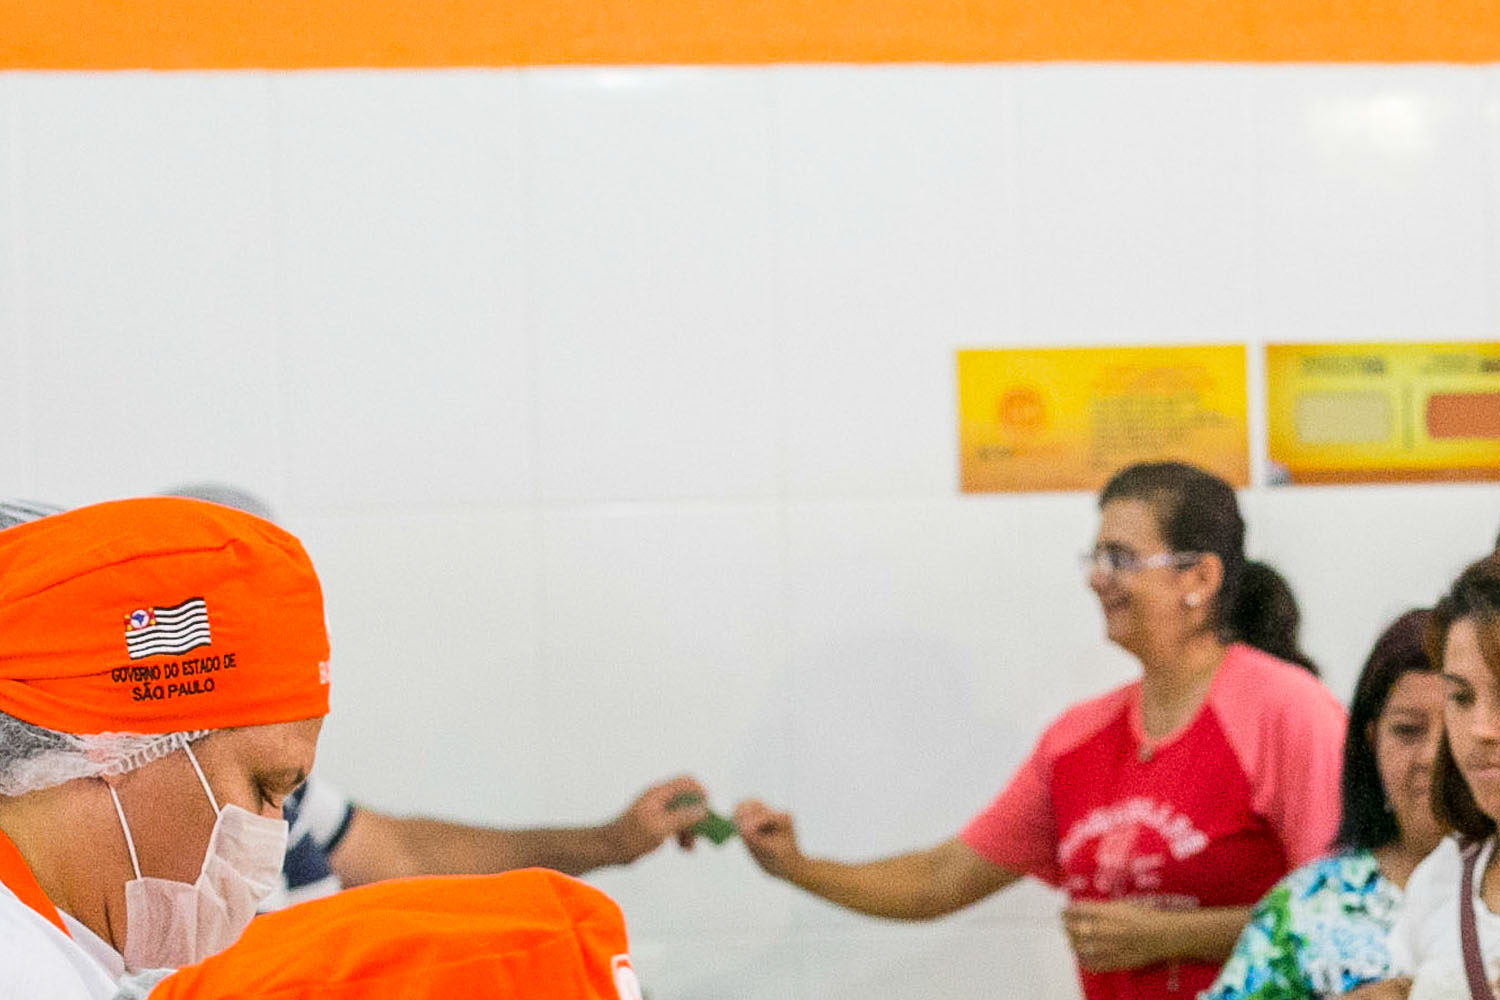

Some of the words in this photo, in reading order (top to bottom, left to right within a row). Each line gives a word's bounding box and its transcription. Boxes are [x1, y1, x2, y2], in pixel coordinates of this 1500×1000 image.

[111, 665, 161, 682] GOVERNO
[164, 662, 179, 679] DO
[182, 656, 221, 676] ESTADO
[224, 653, 236, 669] DE
[132, 681, 164, 701] SÃO
[168, 678, 215, 698] PAULO
